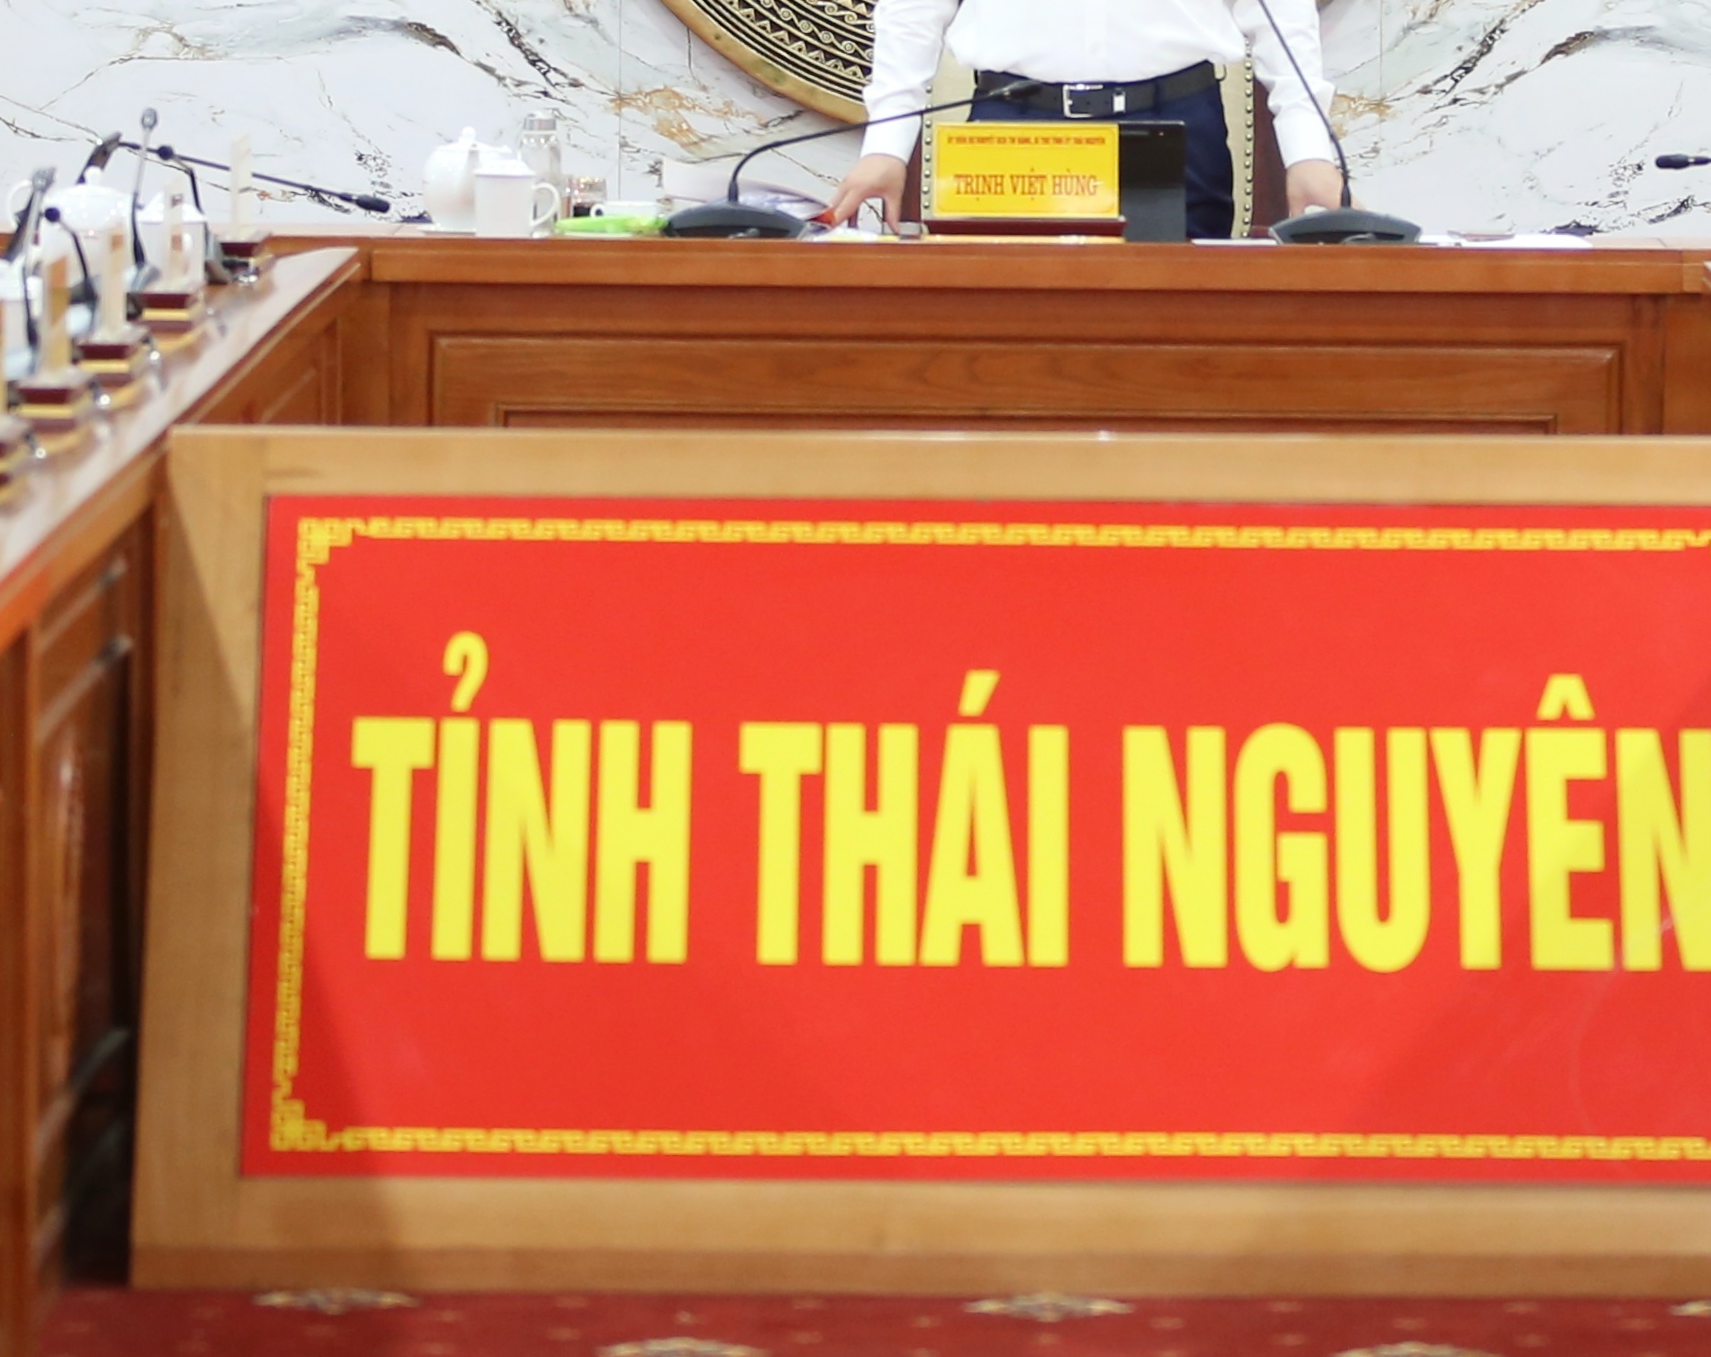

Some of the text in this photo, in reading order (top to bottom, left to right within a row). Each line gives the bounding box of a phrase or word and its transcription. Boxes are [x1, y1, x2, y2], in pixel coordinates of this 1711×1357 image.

[953, 167, 1099, 201] TRỊNH VIỆT HÙNG
[353, 633, 692, 962] TỈNH
[740, 671, 1068, 966] THÁI
